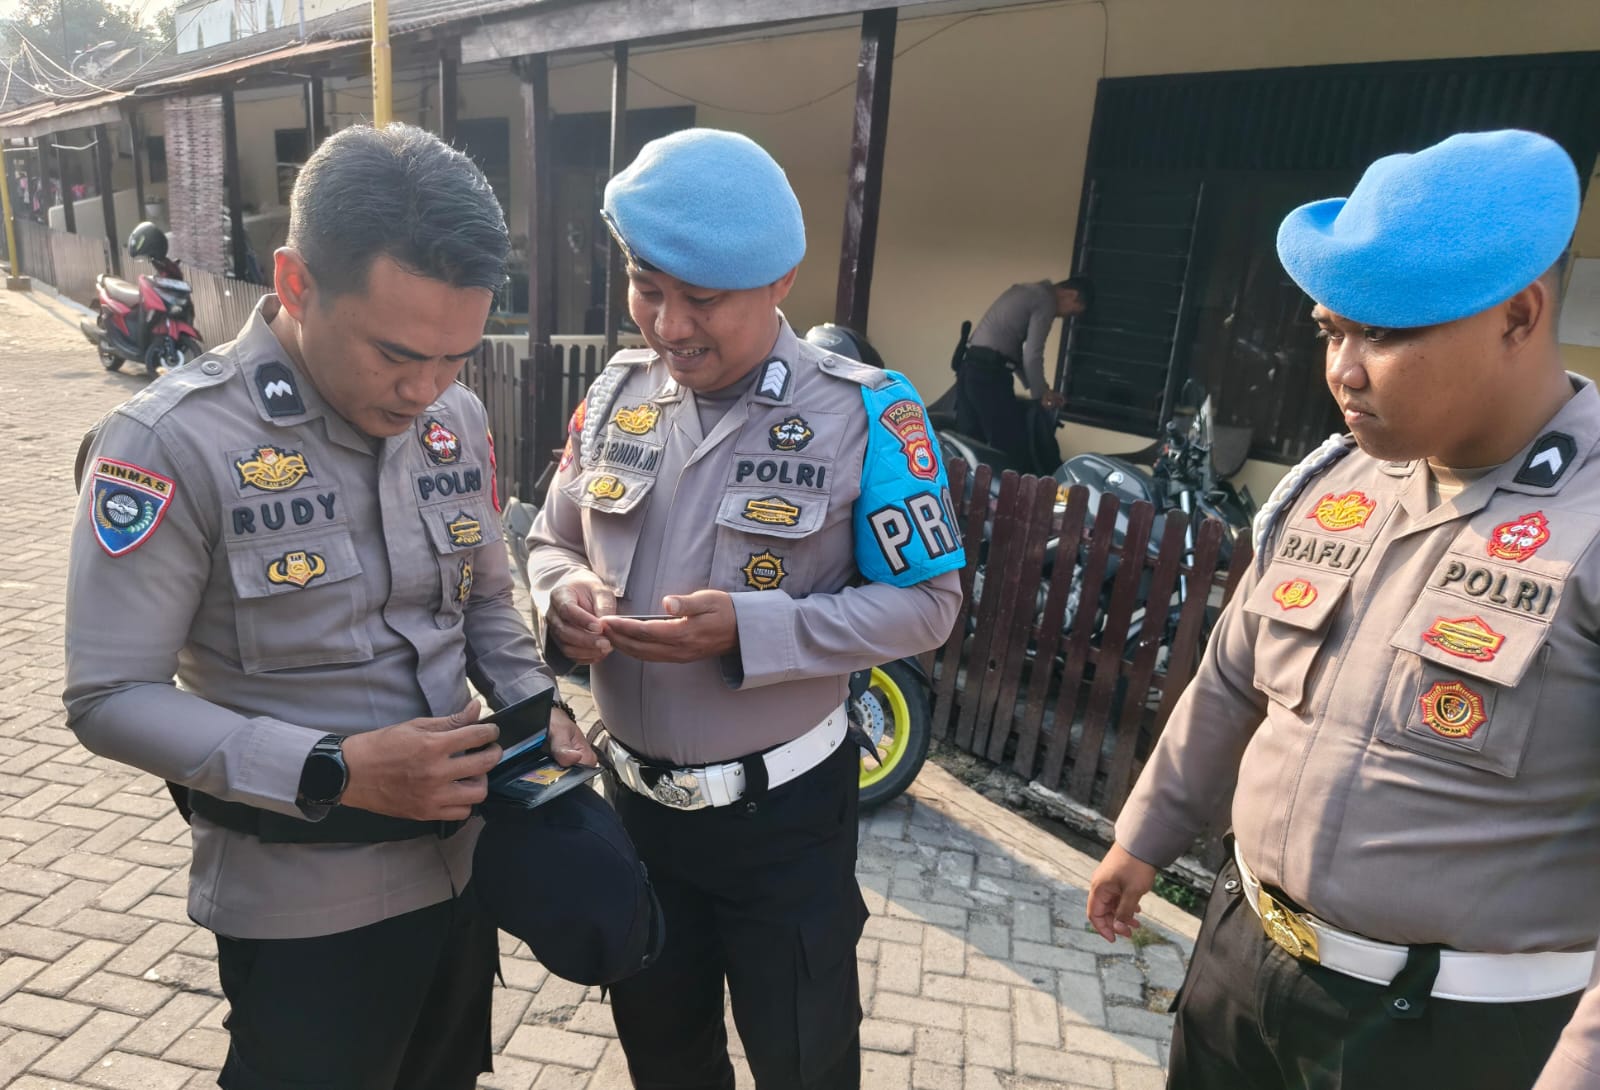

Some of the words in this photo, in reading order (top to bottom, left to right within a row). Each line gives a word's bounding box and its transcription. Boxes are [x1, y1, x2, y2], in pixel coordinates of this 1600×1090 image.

[101, 463, 167, 491] BINMAS
[418, 466, 482, 501] POLRI
[736, 460, 826, 489] POLRI
[231, 492, 336, 536] RUDY
[1281, 535, 1361, 570] RAFLI
[1439, 560, 1553, 615] POLRI
